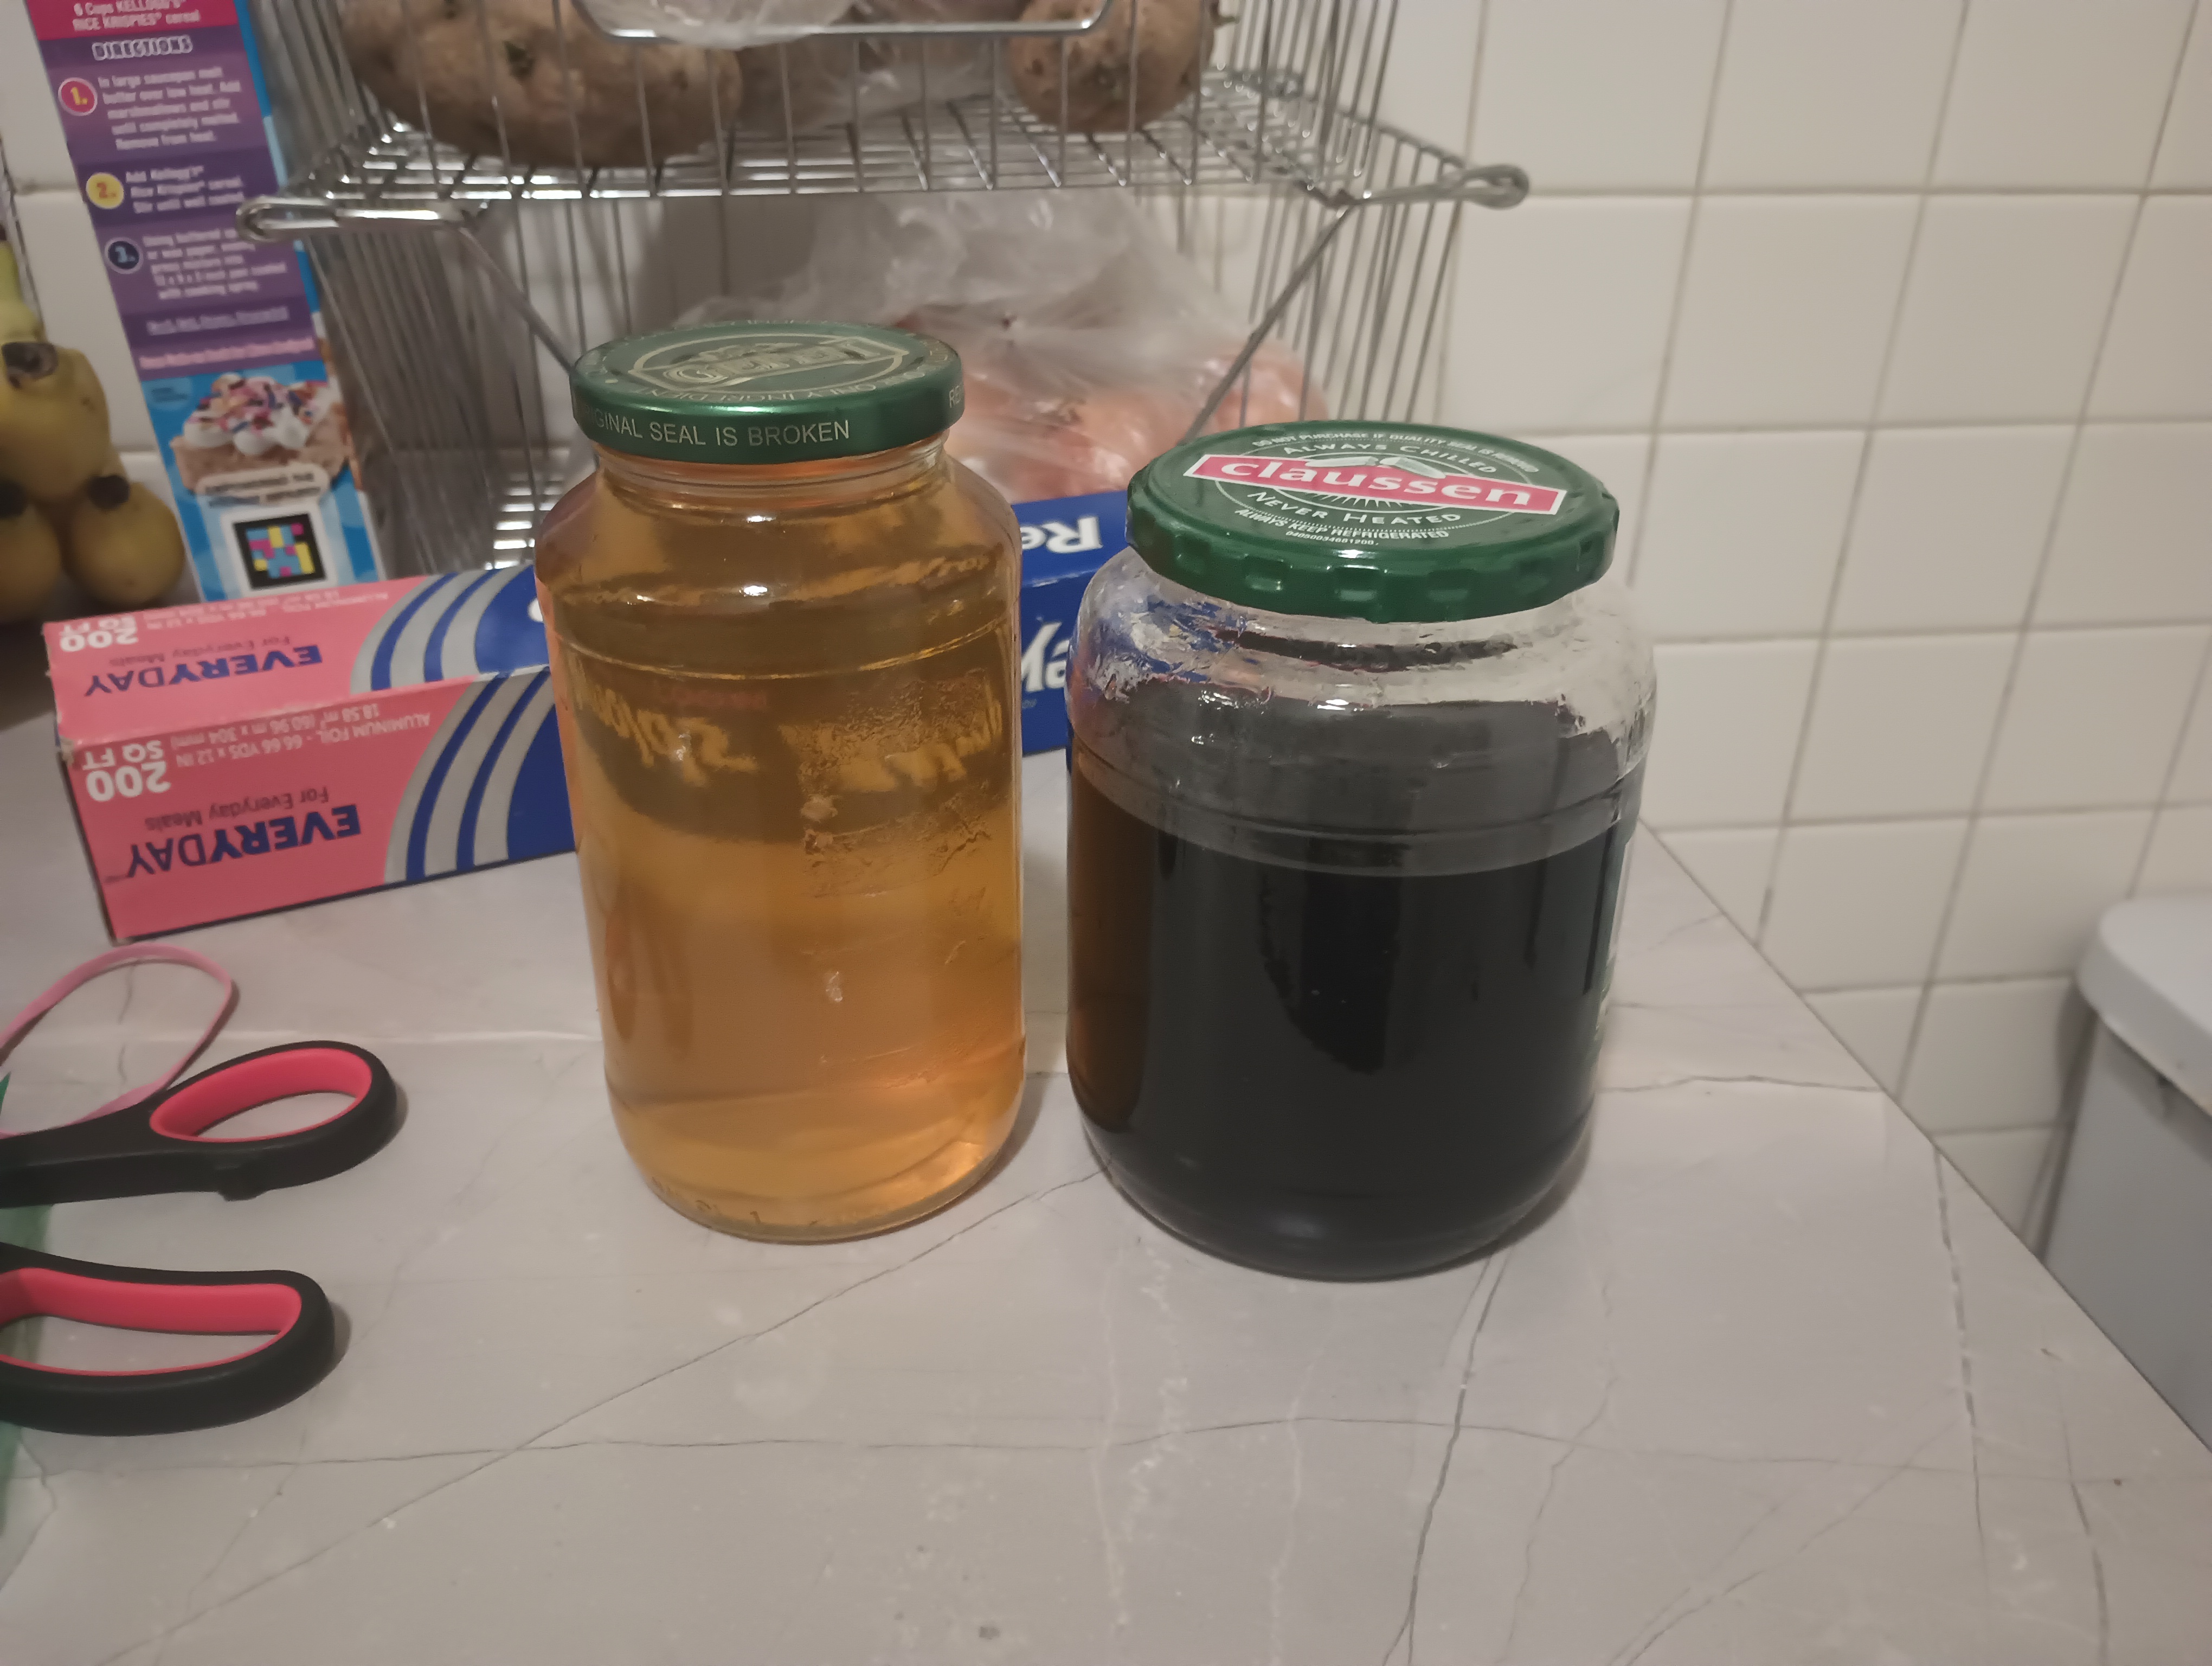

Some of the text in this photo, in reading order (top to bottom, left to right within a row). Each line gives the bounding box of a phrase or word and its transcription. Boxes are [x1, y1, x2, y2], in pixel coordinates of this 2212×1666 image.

[650, 421, 706, 445] SEAL
[716, 426, 738, 446] IS
[748, 419, 850, 446] BROKEN
[1284, 443, 1387, 454] ALWAYS
[1399, 445, 1497, 473] CHILLED
[1221, 460, 1531, 506] claussen
[1247, 491, 1461, 524] NEVER HEATED
[1234, 509, 1450, 540] ALWAYS KEEP REFRIGERATED
[59, 629, 139, 652] 200
[83, 644, 324, 697] EVERYDAY
[82, 739, 165, 771] SQ FT
[86, 760, 172, 803] 200
[144, 786, 330, 832] For Everyday Meals
[127, 804, 362, 878] EVERYDAY
